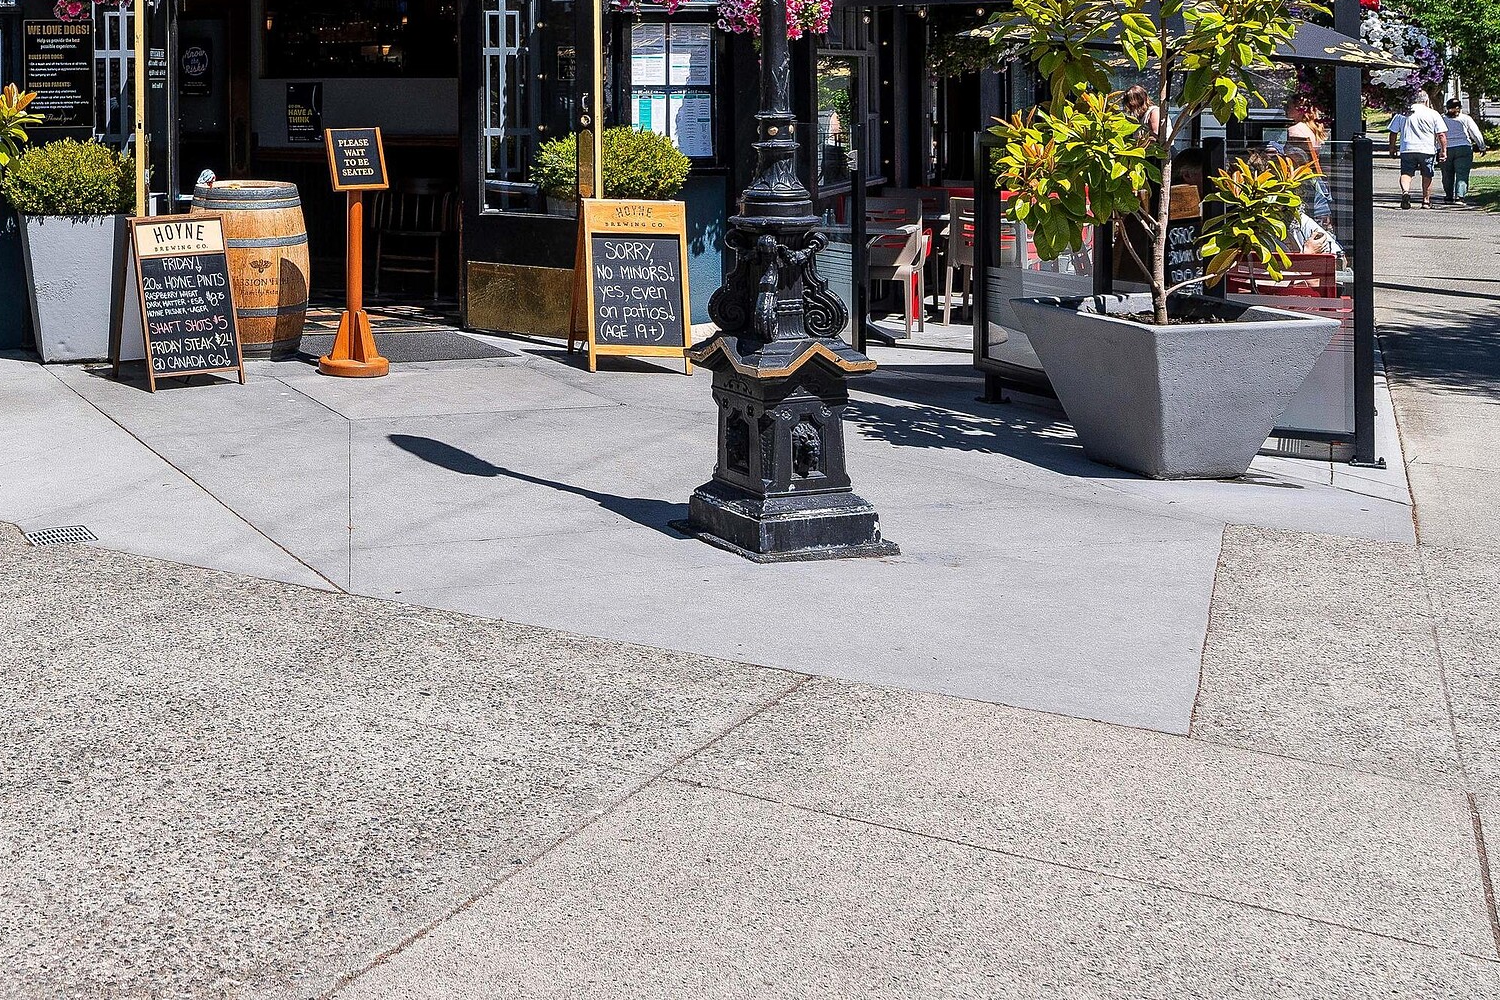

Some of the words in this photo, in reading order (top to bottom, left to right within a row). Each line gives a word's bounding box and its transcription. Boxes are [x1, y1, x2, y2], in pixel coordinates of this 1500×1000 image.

[27, 25, 40, 35] WE
[42, 25, 62, 35] LOVE
[64, 25, 90, 35] DOGS!
[338, 139, 369, 147] PLEASE
[358, 158, 369, 166] BE
[342, 168, 374, 176] SEATED
[616, 206, 652, 218] HOYNE
[153, 223, 204, 244] HOYNE
[154, 244, 191, 252] BREWING
[604, 242, 654, 265] SORRY,
[162, 256, 202, 272] FRIDAY!
[596, 264, 613, 280] NO
[620, 262, 675, 282] MINORS!
[164, 276, 196, 289] HOYNE
[197, 273, 225, 287] PINTS
[145, 291, 177, 300] RASPBERRY
[180, 290, 198, 298] WHEAT
[163, 299, 186, 307] MATTER
[191, 297, 204, 305] ESB
[599, 286, 629, 302] yes,
[632, 286, 667, 300] even
[147, 310, 164, 318] HOYNE
[600, 306, 618, 318] on
[623, 301, 675, 323] patios!
[150, 321, 181, 334] SHAFT
[185, 318, 213, 332] SHOTS
[213, 315, 228, 330] $5
[601, 320, 628, 341] (AGE
[635, 322, 664, 341] 19+)
[151, 338, 182, 354] FRIDAY
[184, 336, 217, 351] STEAK
[215, 332, 234, 346] $24
[153, 358, 166, 370] GO
[168, 355, 207, 368] CANADA
[208, 348, 231, 366] GO!
